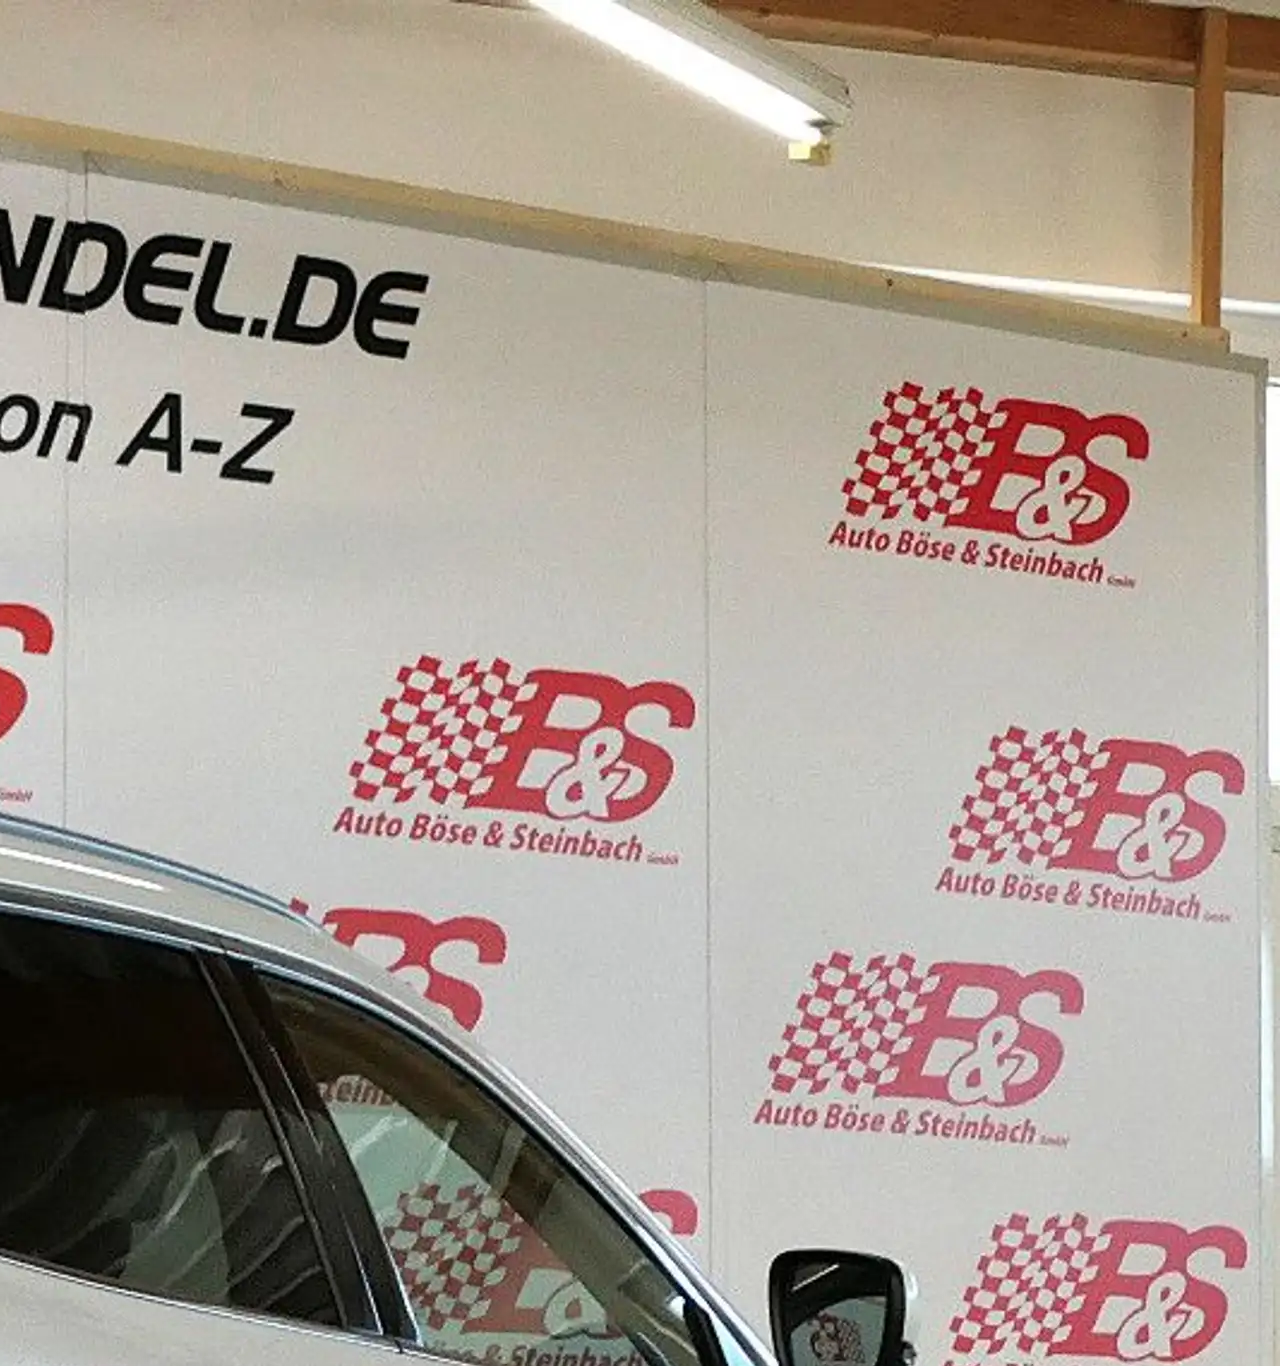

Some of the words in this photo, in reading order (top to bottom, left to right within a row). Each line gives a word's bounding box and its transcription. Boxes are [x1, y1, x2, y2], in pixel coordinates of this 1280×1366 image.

[116, 393, 295, 484] A-Z
[828, 521, 890, 552] Auto
[896, 529, 954, 562] Böse
[961, 540, 980, 565] &
[985, 542, 1104, 584] Steinbach
[333, 806, 402, 836] Auto
[408, 813, 477, 845] Böse
[483, 822, 503, 847] &
[510, 823, 643, 862] Steinbach
[935, 866, 995, 895] Auto
[1001, 873, 1058, 902] Böse
[1063, 880, 1081, 905] &
[1086, 881, 1201, 922] Steinbach
[754, 1099, 817, 1127] Auto
[824, 1104, 885, 1132] Böse
[890, 1109, 910, 1135] &
[914, 1110, 1036, 1145] Steinbach
